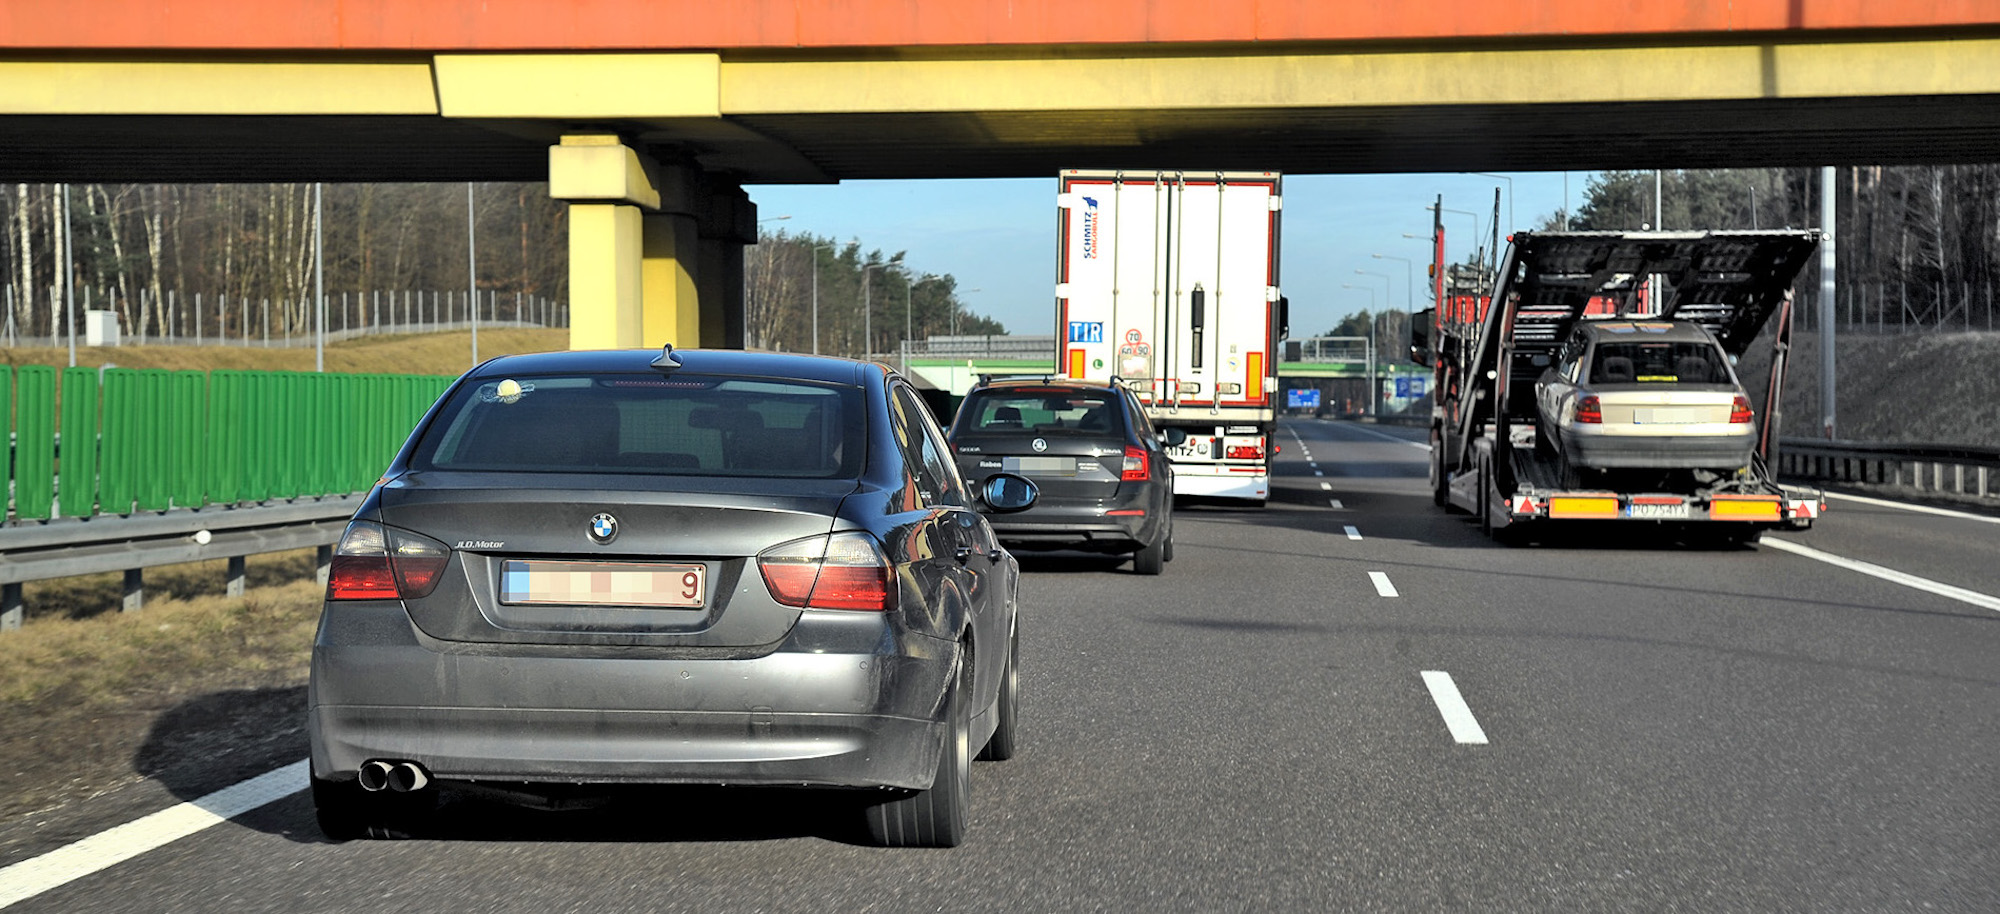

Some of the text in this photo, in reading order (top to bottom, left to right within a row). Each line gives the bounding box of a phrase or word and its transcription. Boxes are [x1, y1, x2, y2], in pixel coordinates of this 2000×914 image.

[1084, 212, 1092, 259] SCHMITZ
[1071, 323, 1101, 341] TIR
[1129, 333, 1140, 342] 70
[1138, 346, 1149, 355] 90
[682, 572, 698, 599] 9
